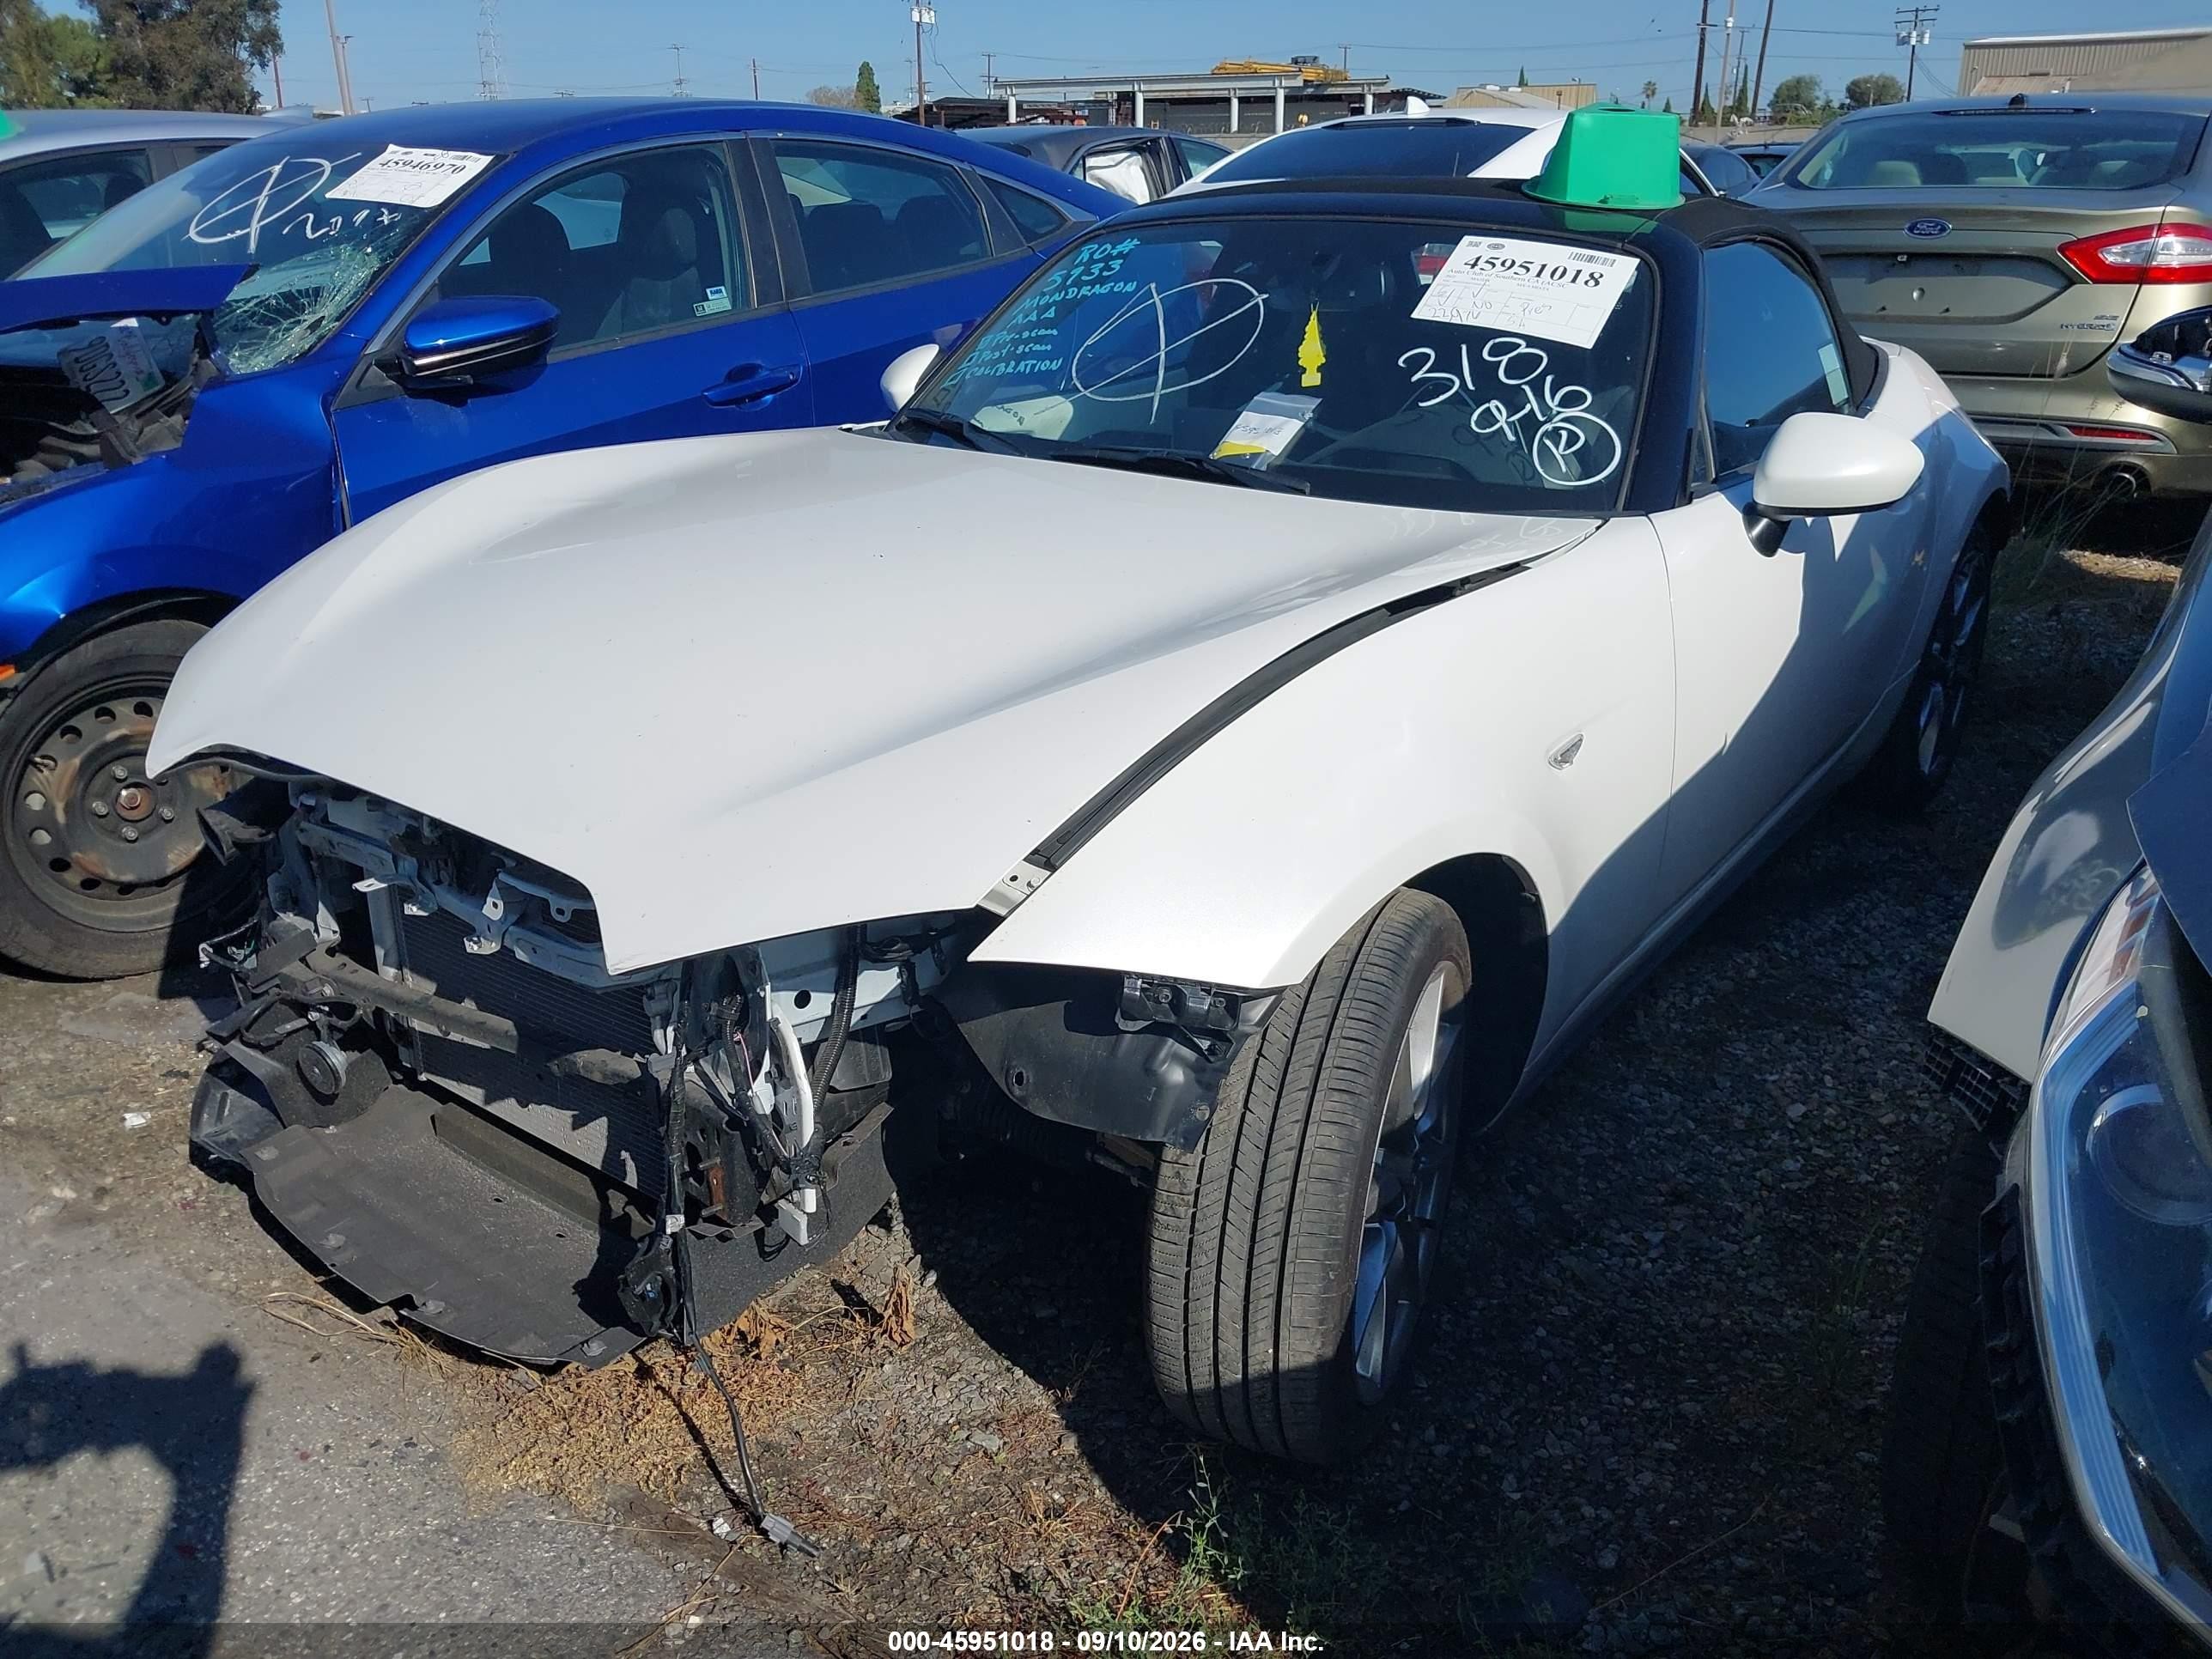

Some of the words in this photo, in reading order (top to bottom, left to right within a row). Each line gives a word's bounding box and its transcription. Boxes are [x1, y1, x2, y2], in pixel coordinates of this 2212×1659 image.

[379, 158, 466, 174] 45946970
[1074, 238, 1140, 265] RO#
[1463, 255, 1604, 288] 45951018
[1494, 273, 1526, 283] Southern
[1012, 281, 1137, 316] MONDRAGON
[1397, 337, 1548, 407] 318
